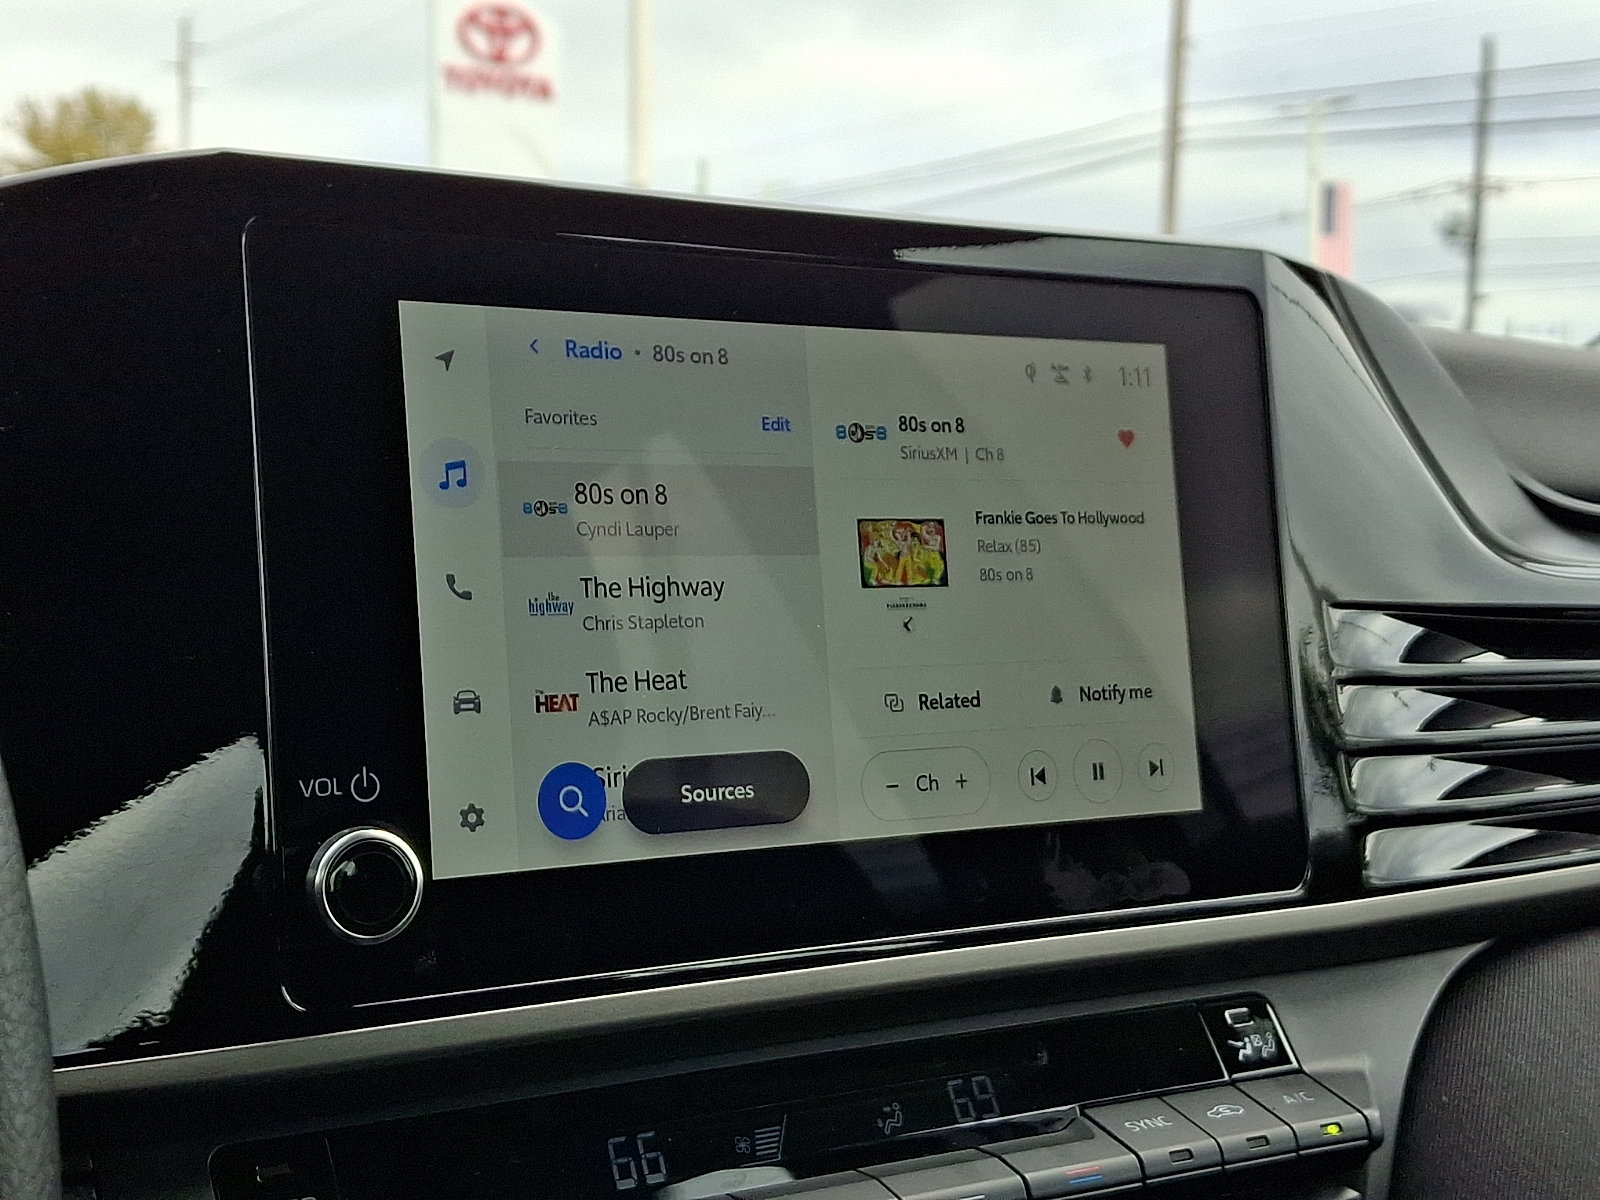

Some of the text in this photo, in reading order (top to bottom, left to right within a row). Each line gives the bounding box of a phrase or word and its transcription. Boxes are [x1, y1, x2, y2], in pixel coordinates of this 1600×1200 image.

[565, 339, 622, 361] Radio
[652, 345, 729, 365] 80s on 8
[1118, 366, 1150, 387] 1:11
[525, 408, 598, 427] Favorites
[762, 417, 791, 432] Edit
[898, 416, 965, 433] 80s on 8
[900, 446, 958, 460] SiriusXM
[975, 447, 995, 461] Ch
[996, 448, 1005, 461] 8
[574, 482, 668, 505] 80s on 8
[974, 511, 1145, 529] Frankie Goes To Hollywood
[576, 521, 680, 540] Cyndi Lauper
[977, 538, 1041, 555] Relax (85)
[979, 568, 1034, 582] 80s on 8
[579, 575, 725, 603] The Highway
[528, 598, 574, 615] highway
[582, 614, 704, 633] Chris Stapleton
[585, 669, 688, 693] The Heat
[535, 693, 579, 713] HEAT
[918, 690, 981, 711] Related
[1079, 685, 1153, 704] Notify me
[588, 709, 632, 727] A$AP
[636, 704, 731, 726] Rocky/Brent
[299, 777, 342, 798] VOL
[916, 773, 939, 792] Ch
[680, 783, 755, 803] Sources
[603, 805, 626, 821] ria
[947, 1075, 1000, 1123] 69
[1283, 1091, 1315, 1104] A/C
[1124, 1115, 1174, 1132] SYNC
[608, 1131, 666, 1190] 66
